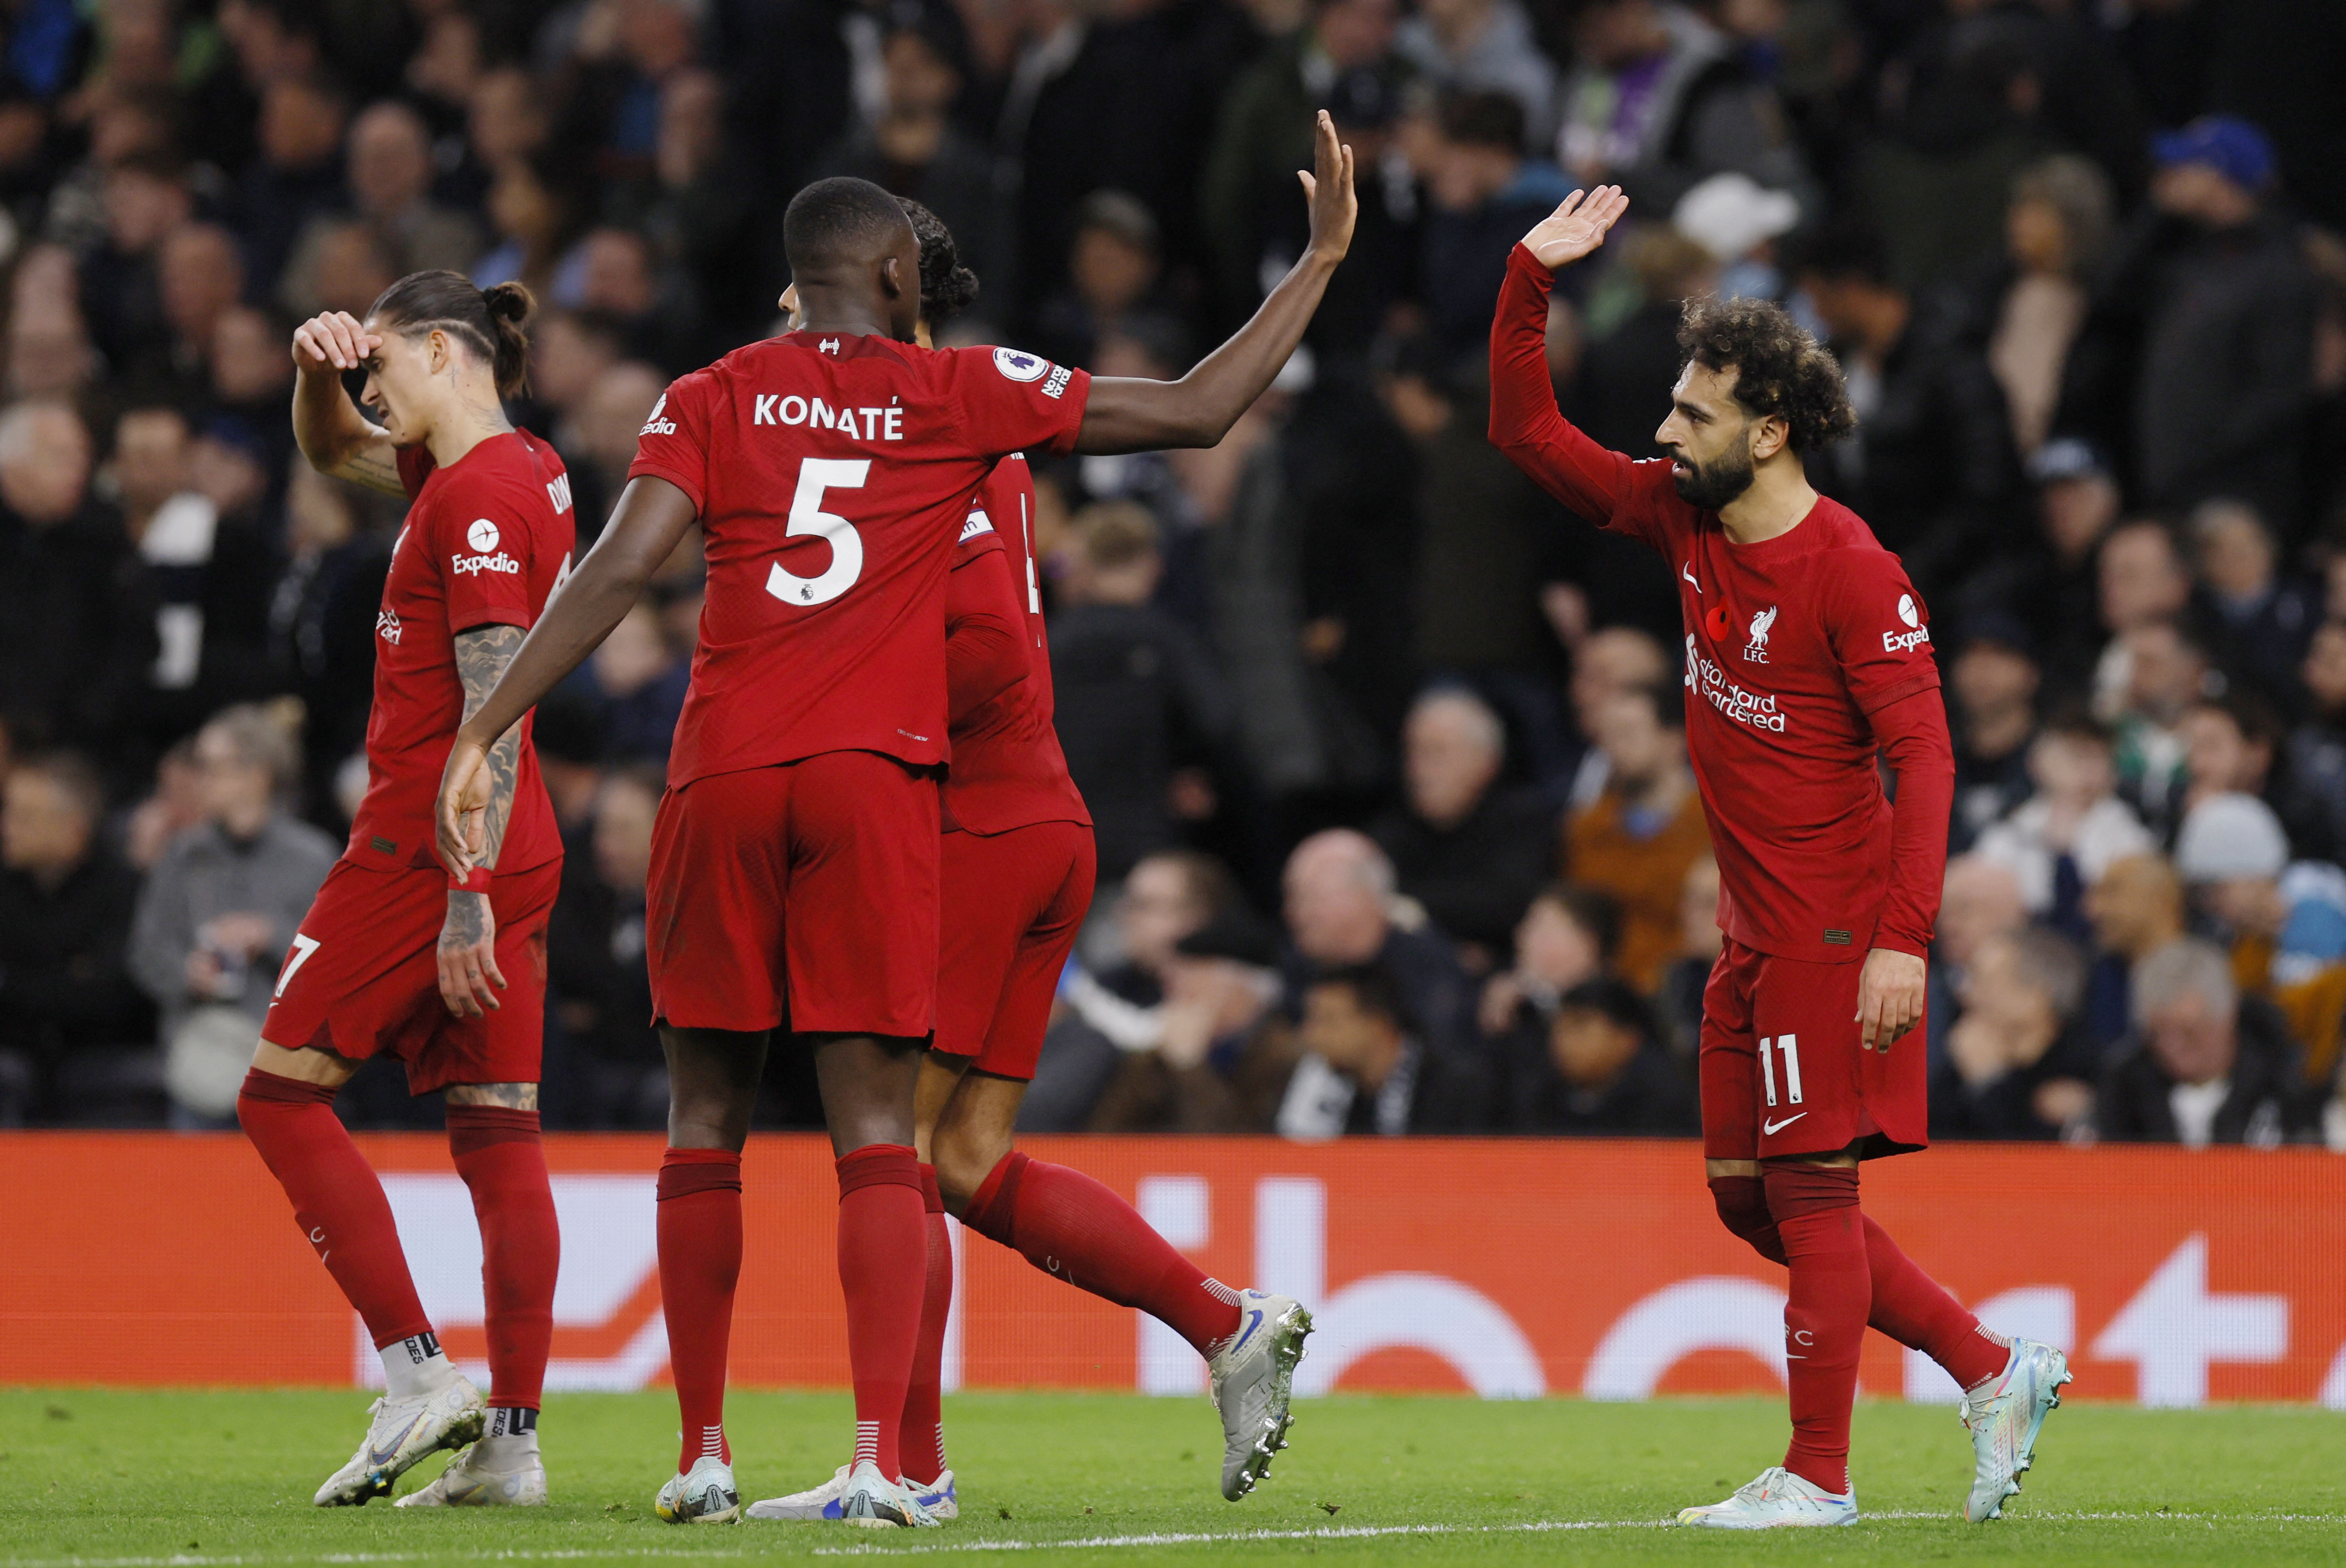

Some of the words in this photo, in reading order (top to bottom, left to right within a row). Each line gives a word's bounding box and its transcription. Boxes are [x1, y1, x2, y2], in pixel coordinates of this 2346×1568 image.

[1041, 380, 1056, 396] No
[1050, 383, 1064, 399] for
[754, 394, 903, 440] KONATÉ
[765, 457, 872, 606] 5
[452, 551, 519, 576] Expedia
[1702, 680, 1785, 733] chartered
[275, 933, 321, 998] 7
[1759, 1034, 1803, 1107] 11
